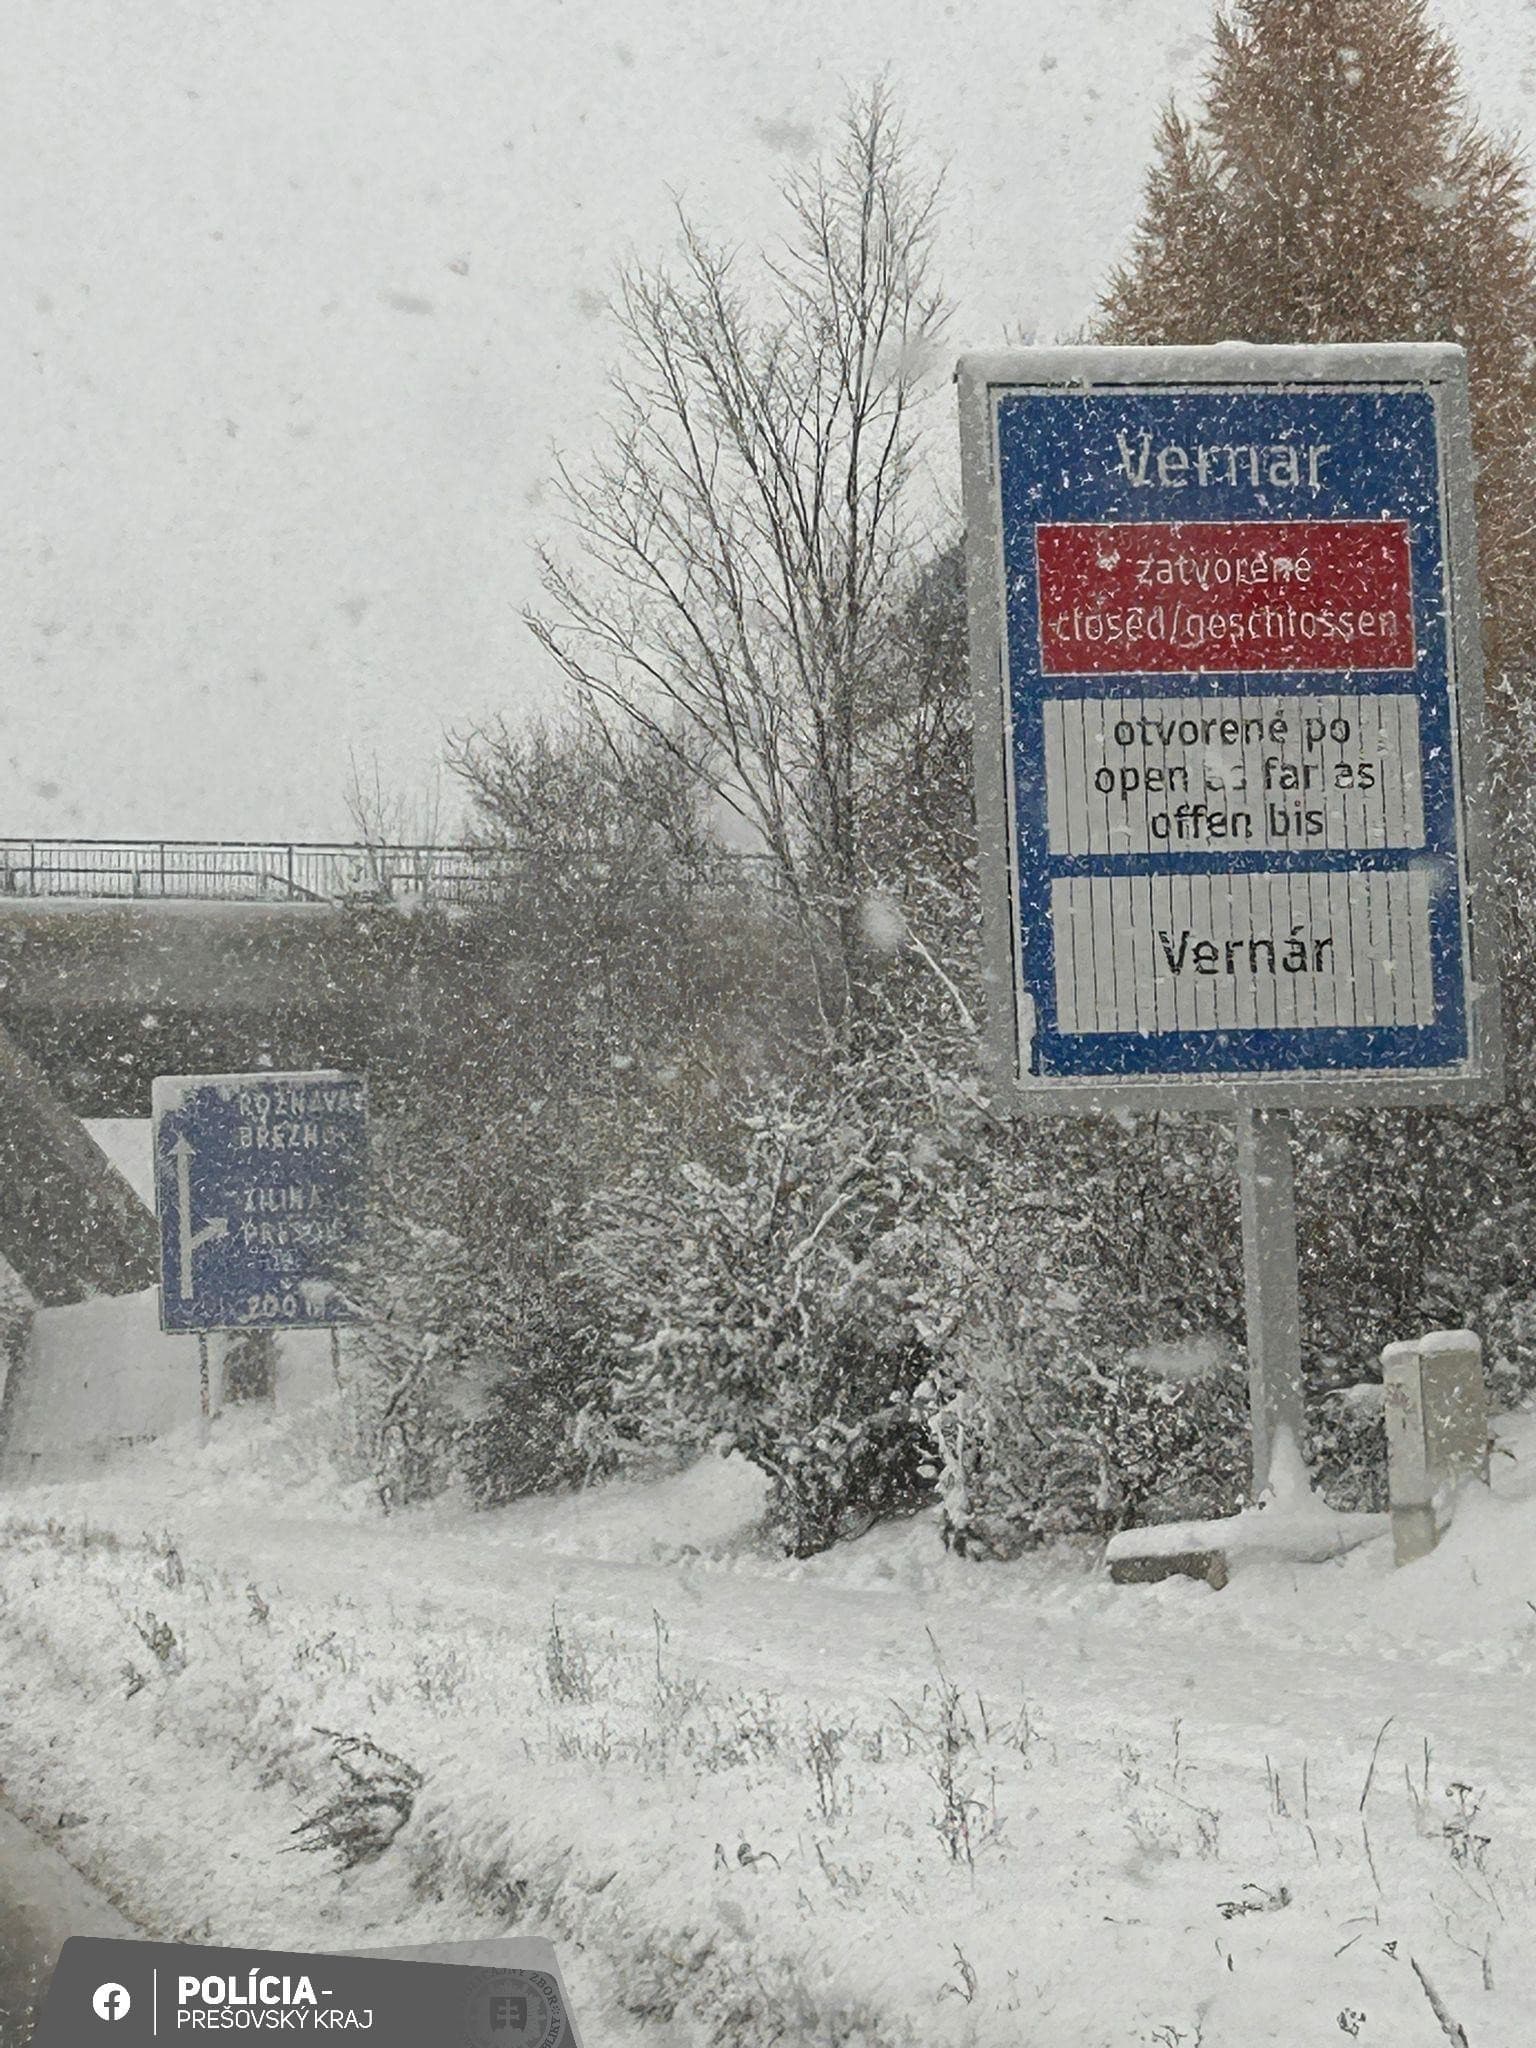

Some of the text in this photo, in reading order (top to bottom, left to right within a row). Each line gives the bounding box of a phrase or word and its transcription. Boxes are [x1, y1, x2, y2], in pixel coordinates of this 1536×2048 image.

[1136, 549, 1312, 591] zatvorené
[1114, 709, 1351, 752] otvorené po
[1094, 765, 1188, 799] open
[1264, 757, 1317, 790] far
[1333, 762, 1376, 790] as
[1151, 802, 1324, 838] offen bis
[1158, 926, 1332, 975] Vernár
